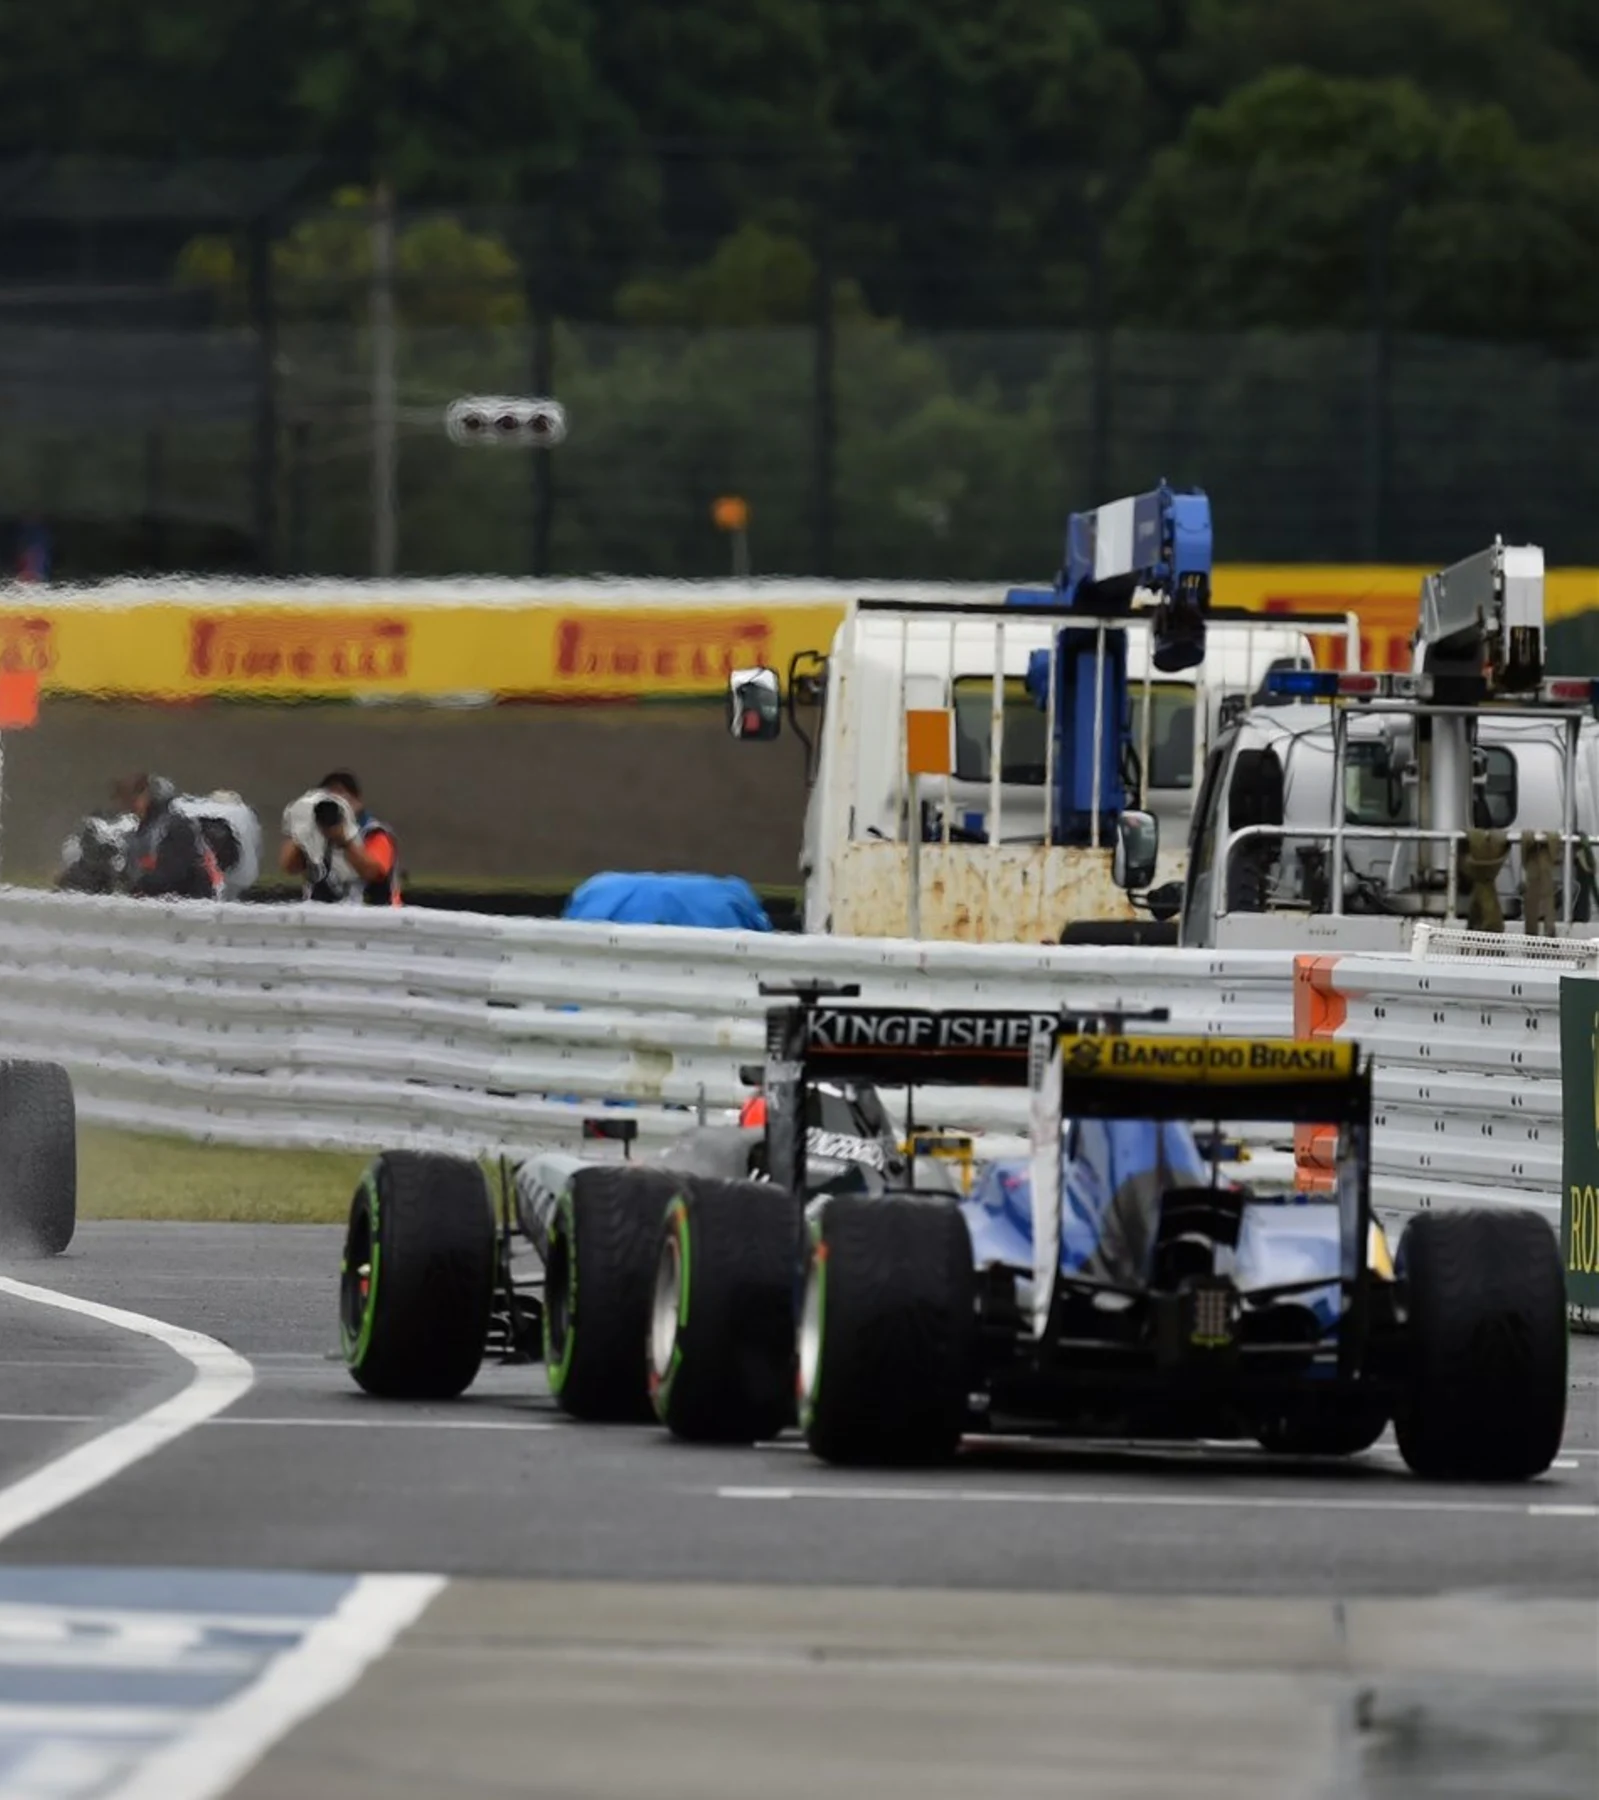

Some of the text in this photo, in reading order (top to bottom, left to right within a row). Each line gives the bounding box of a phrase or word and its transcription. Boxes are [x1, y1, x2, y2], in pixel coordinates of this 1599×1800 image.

[1111, 1041, 1201, 1067] BANCO
[1250, 1043, 1338, 1071] BRASIL
[1570, 1184, 1599, 1274] RO
